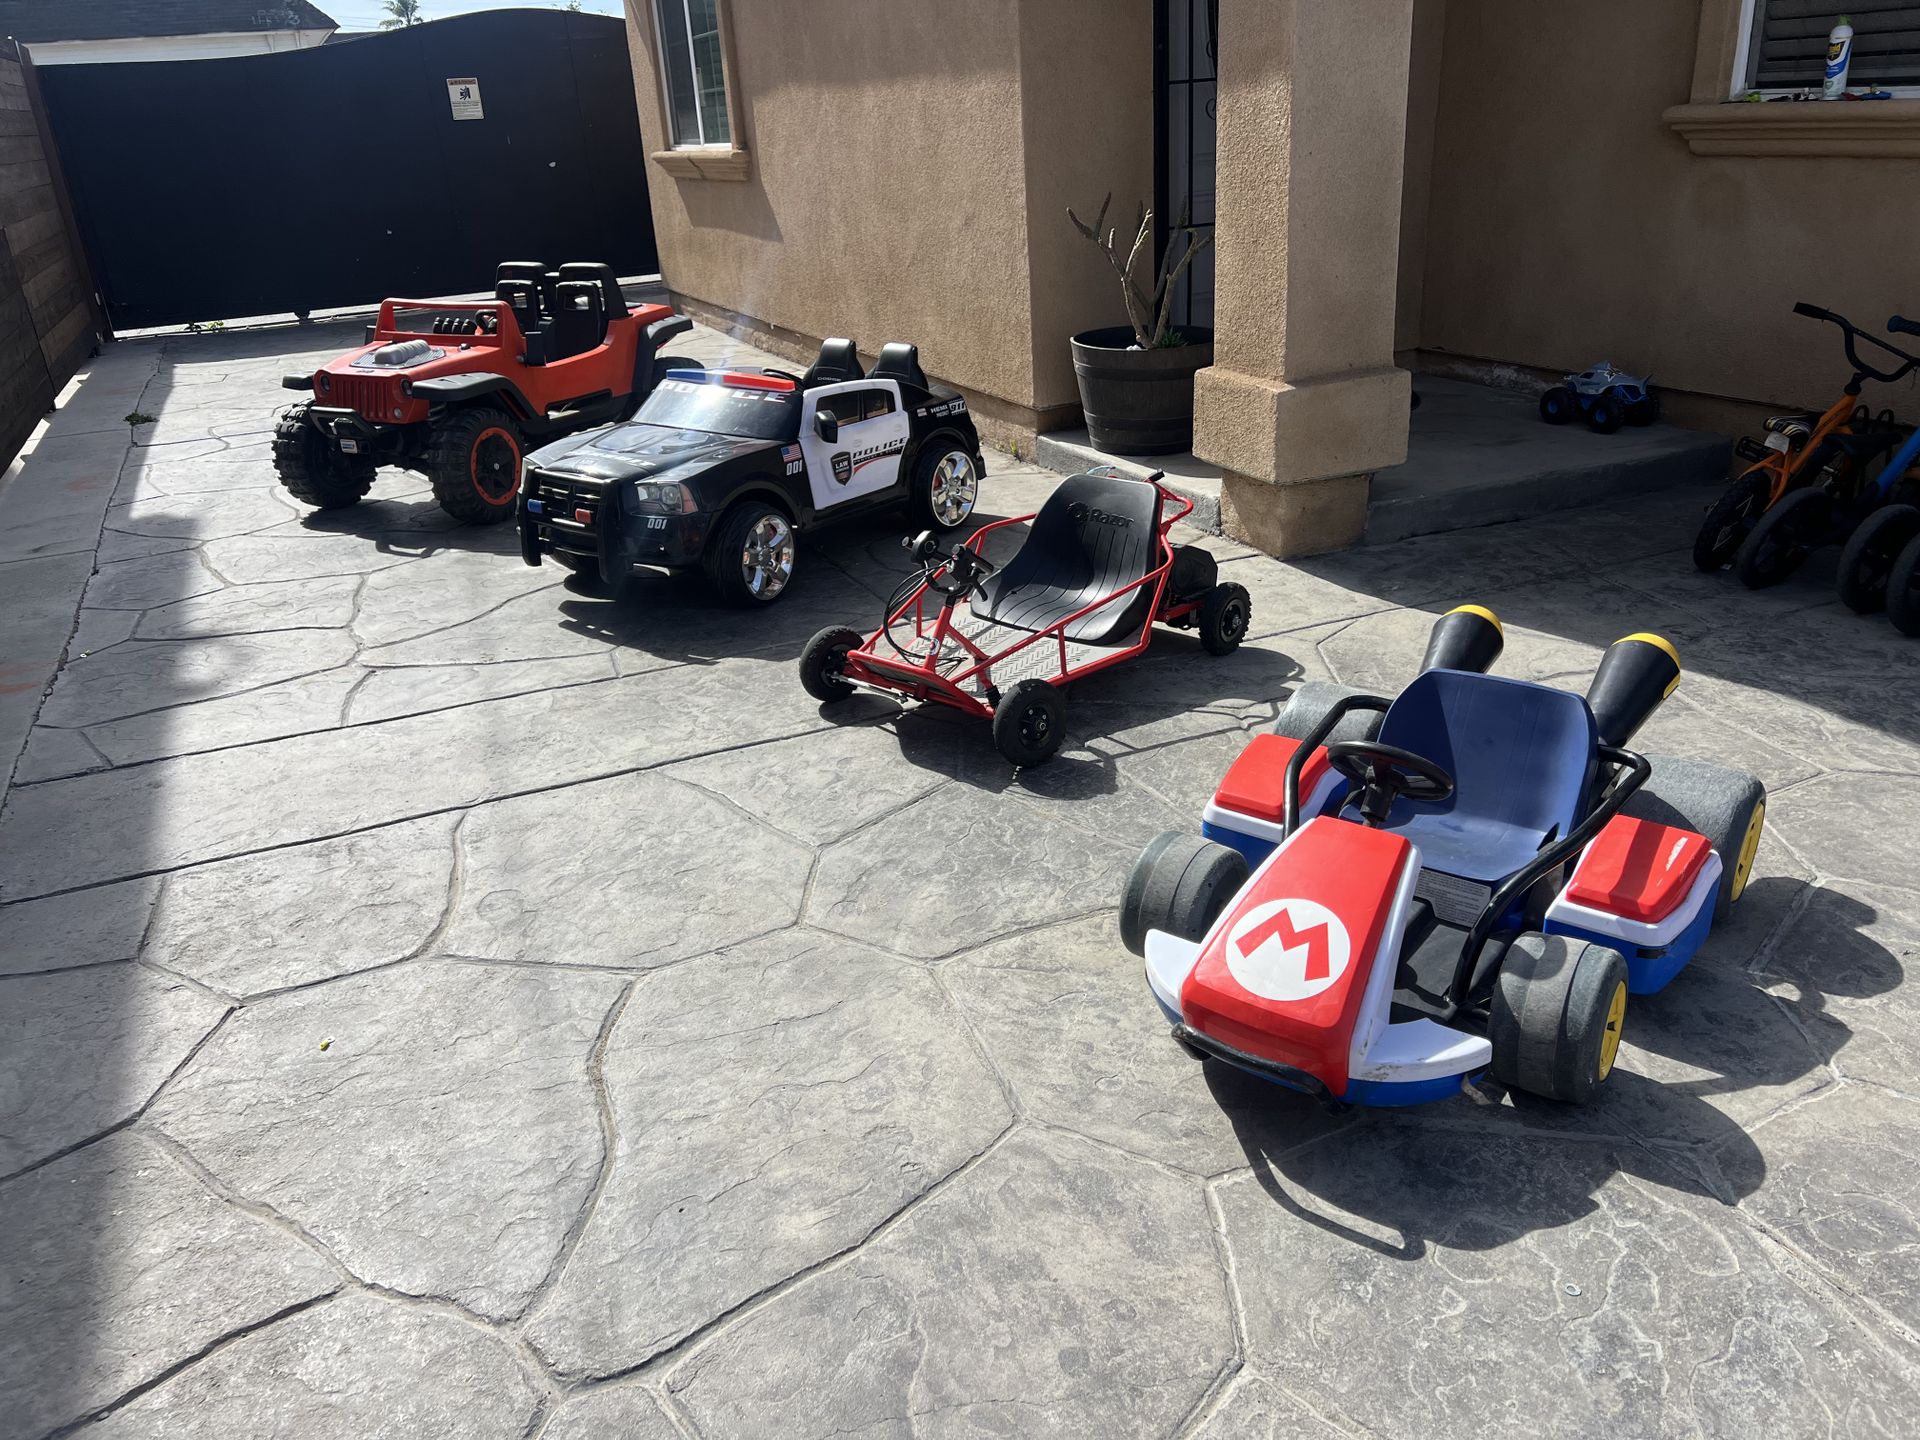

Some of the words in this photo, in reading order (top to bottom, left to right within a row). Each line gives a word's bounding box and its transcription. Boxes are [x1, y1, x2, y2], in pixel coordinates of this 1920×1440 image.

[852, 436, 907, 459] POLICE
[786, 459, 803, 476] 001
[834, 460, 849, 469] LAW
[647, 518, 667, 530] 001
[1089, 508, 1135, 529] Razor
[1235, 907, 1331, 982] M
